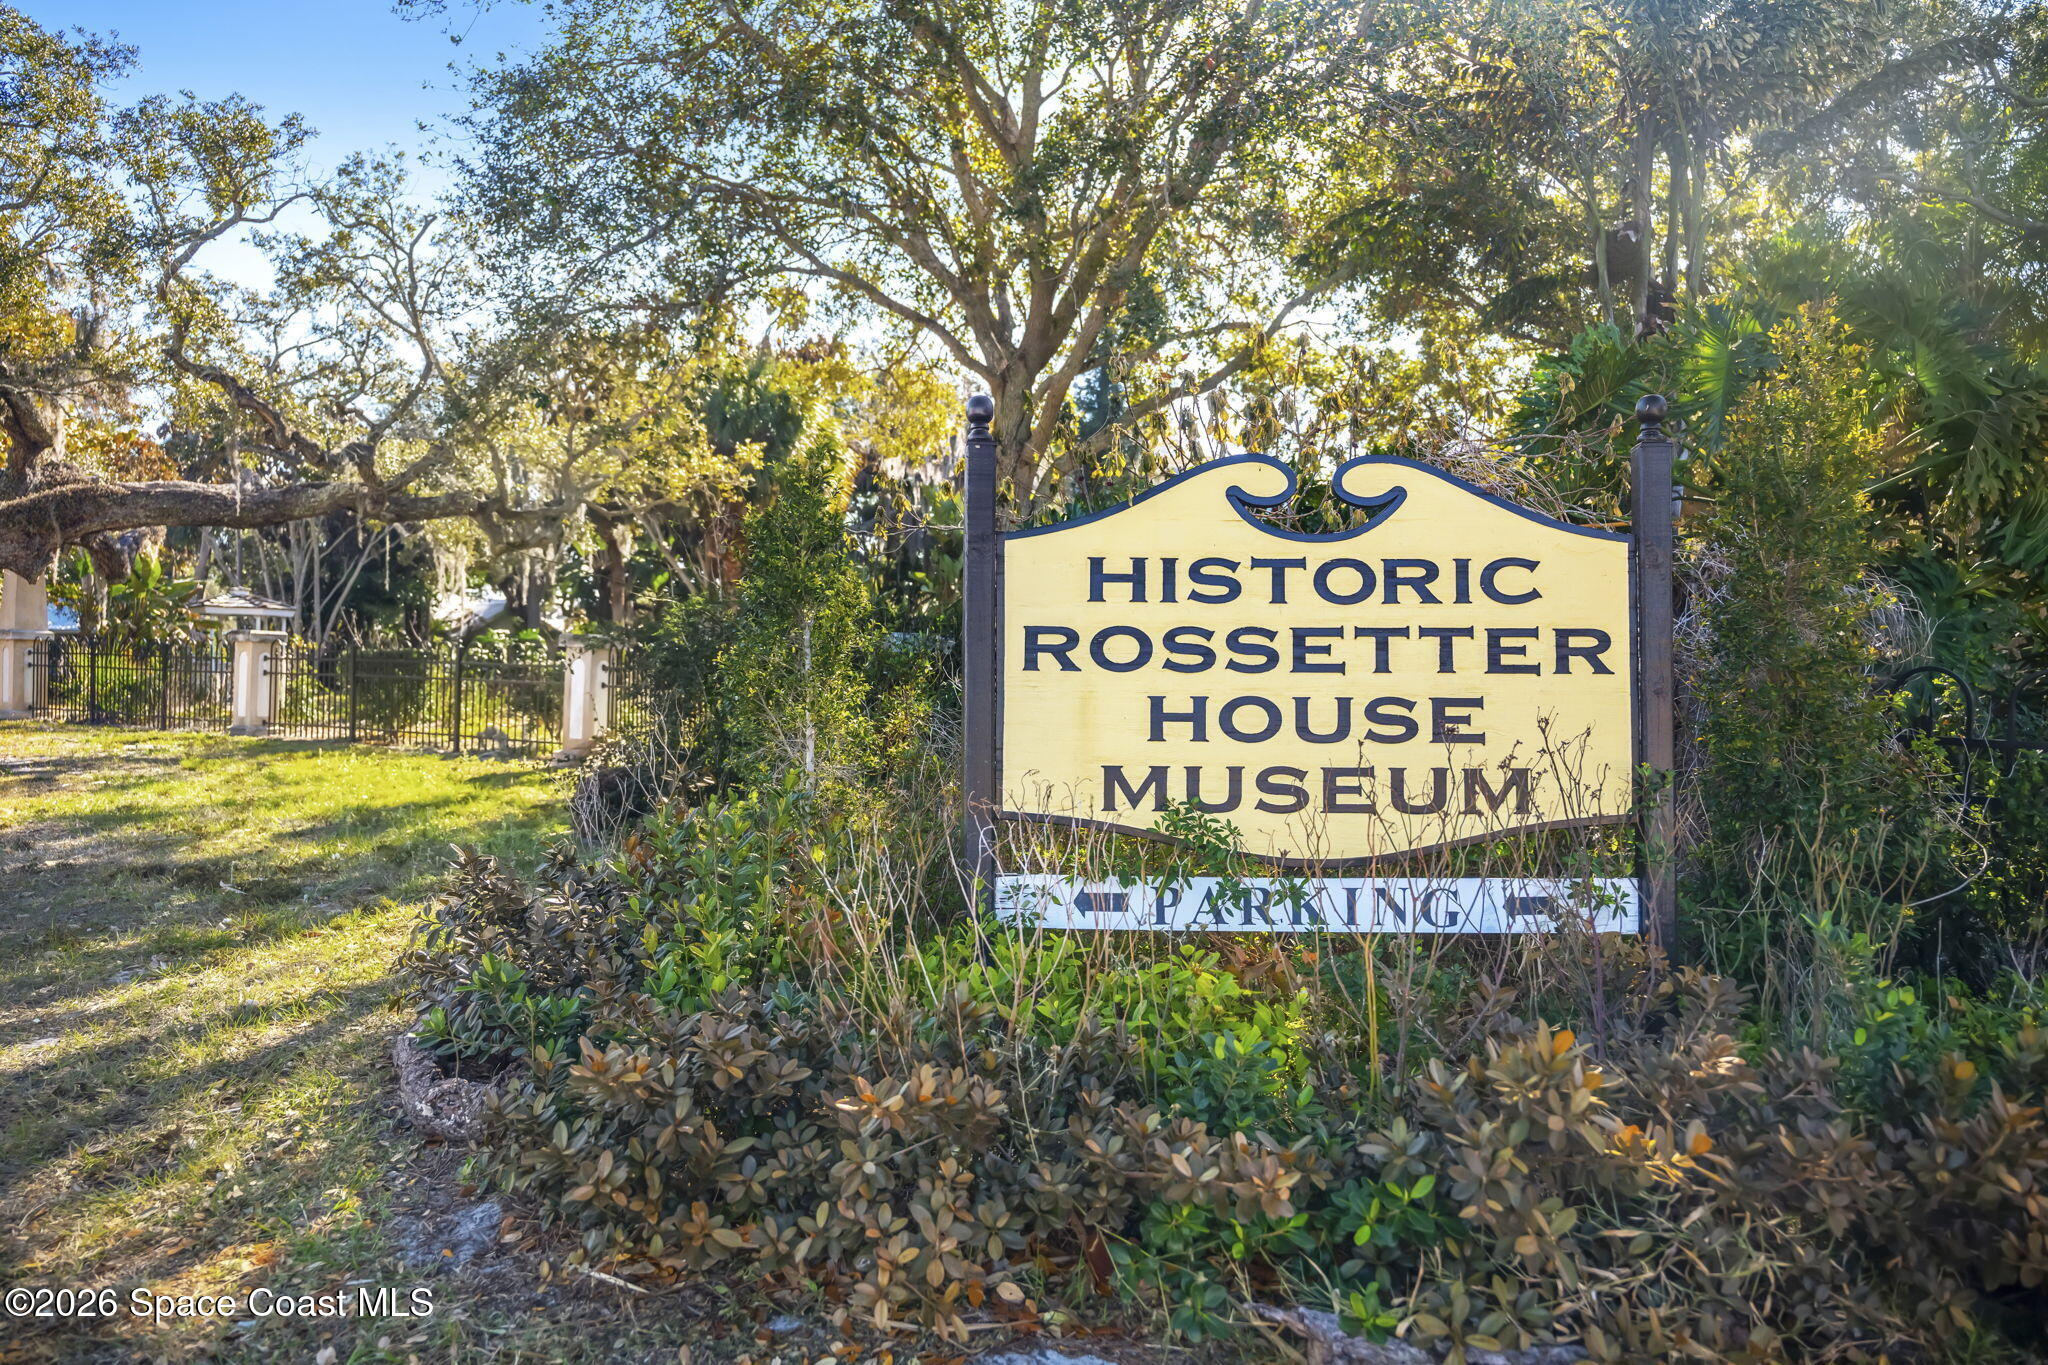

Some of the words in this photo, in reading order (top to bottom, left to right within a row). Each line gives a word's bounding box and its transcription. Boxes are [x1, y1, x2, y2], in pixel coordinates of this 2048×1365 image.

[1087, 557, 1544, 605] HISTORIC
[1022, 625, 1616, 676] ROSSETTER
[1147, 695, 1487, 745] HOUSE
[1101, 764, 1534, 815] MUSEUM
[1153, 884, 1462, 930] PARKING
